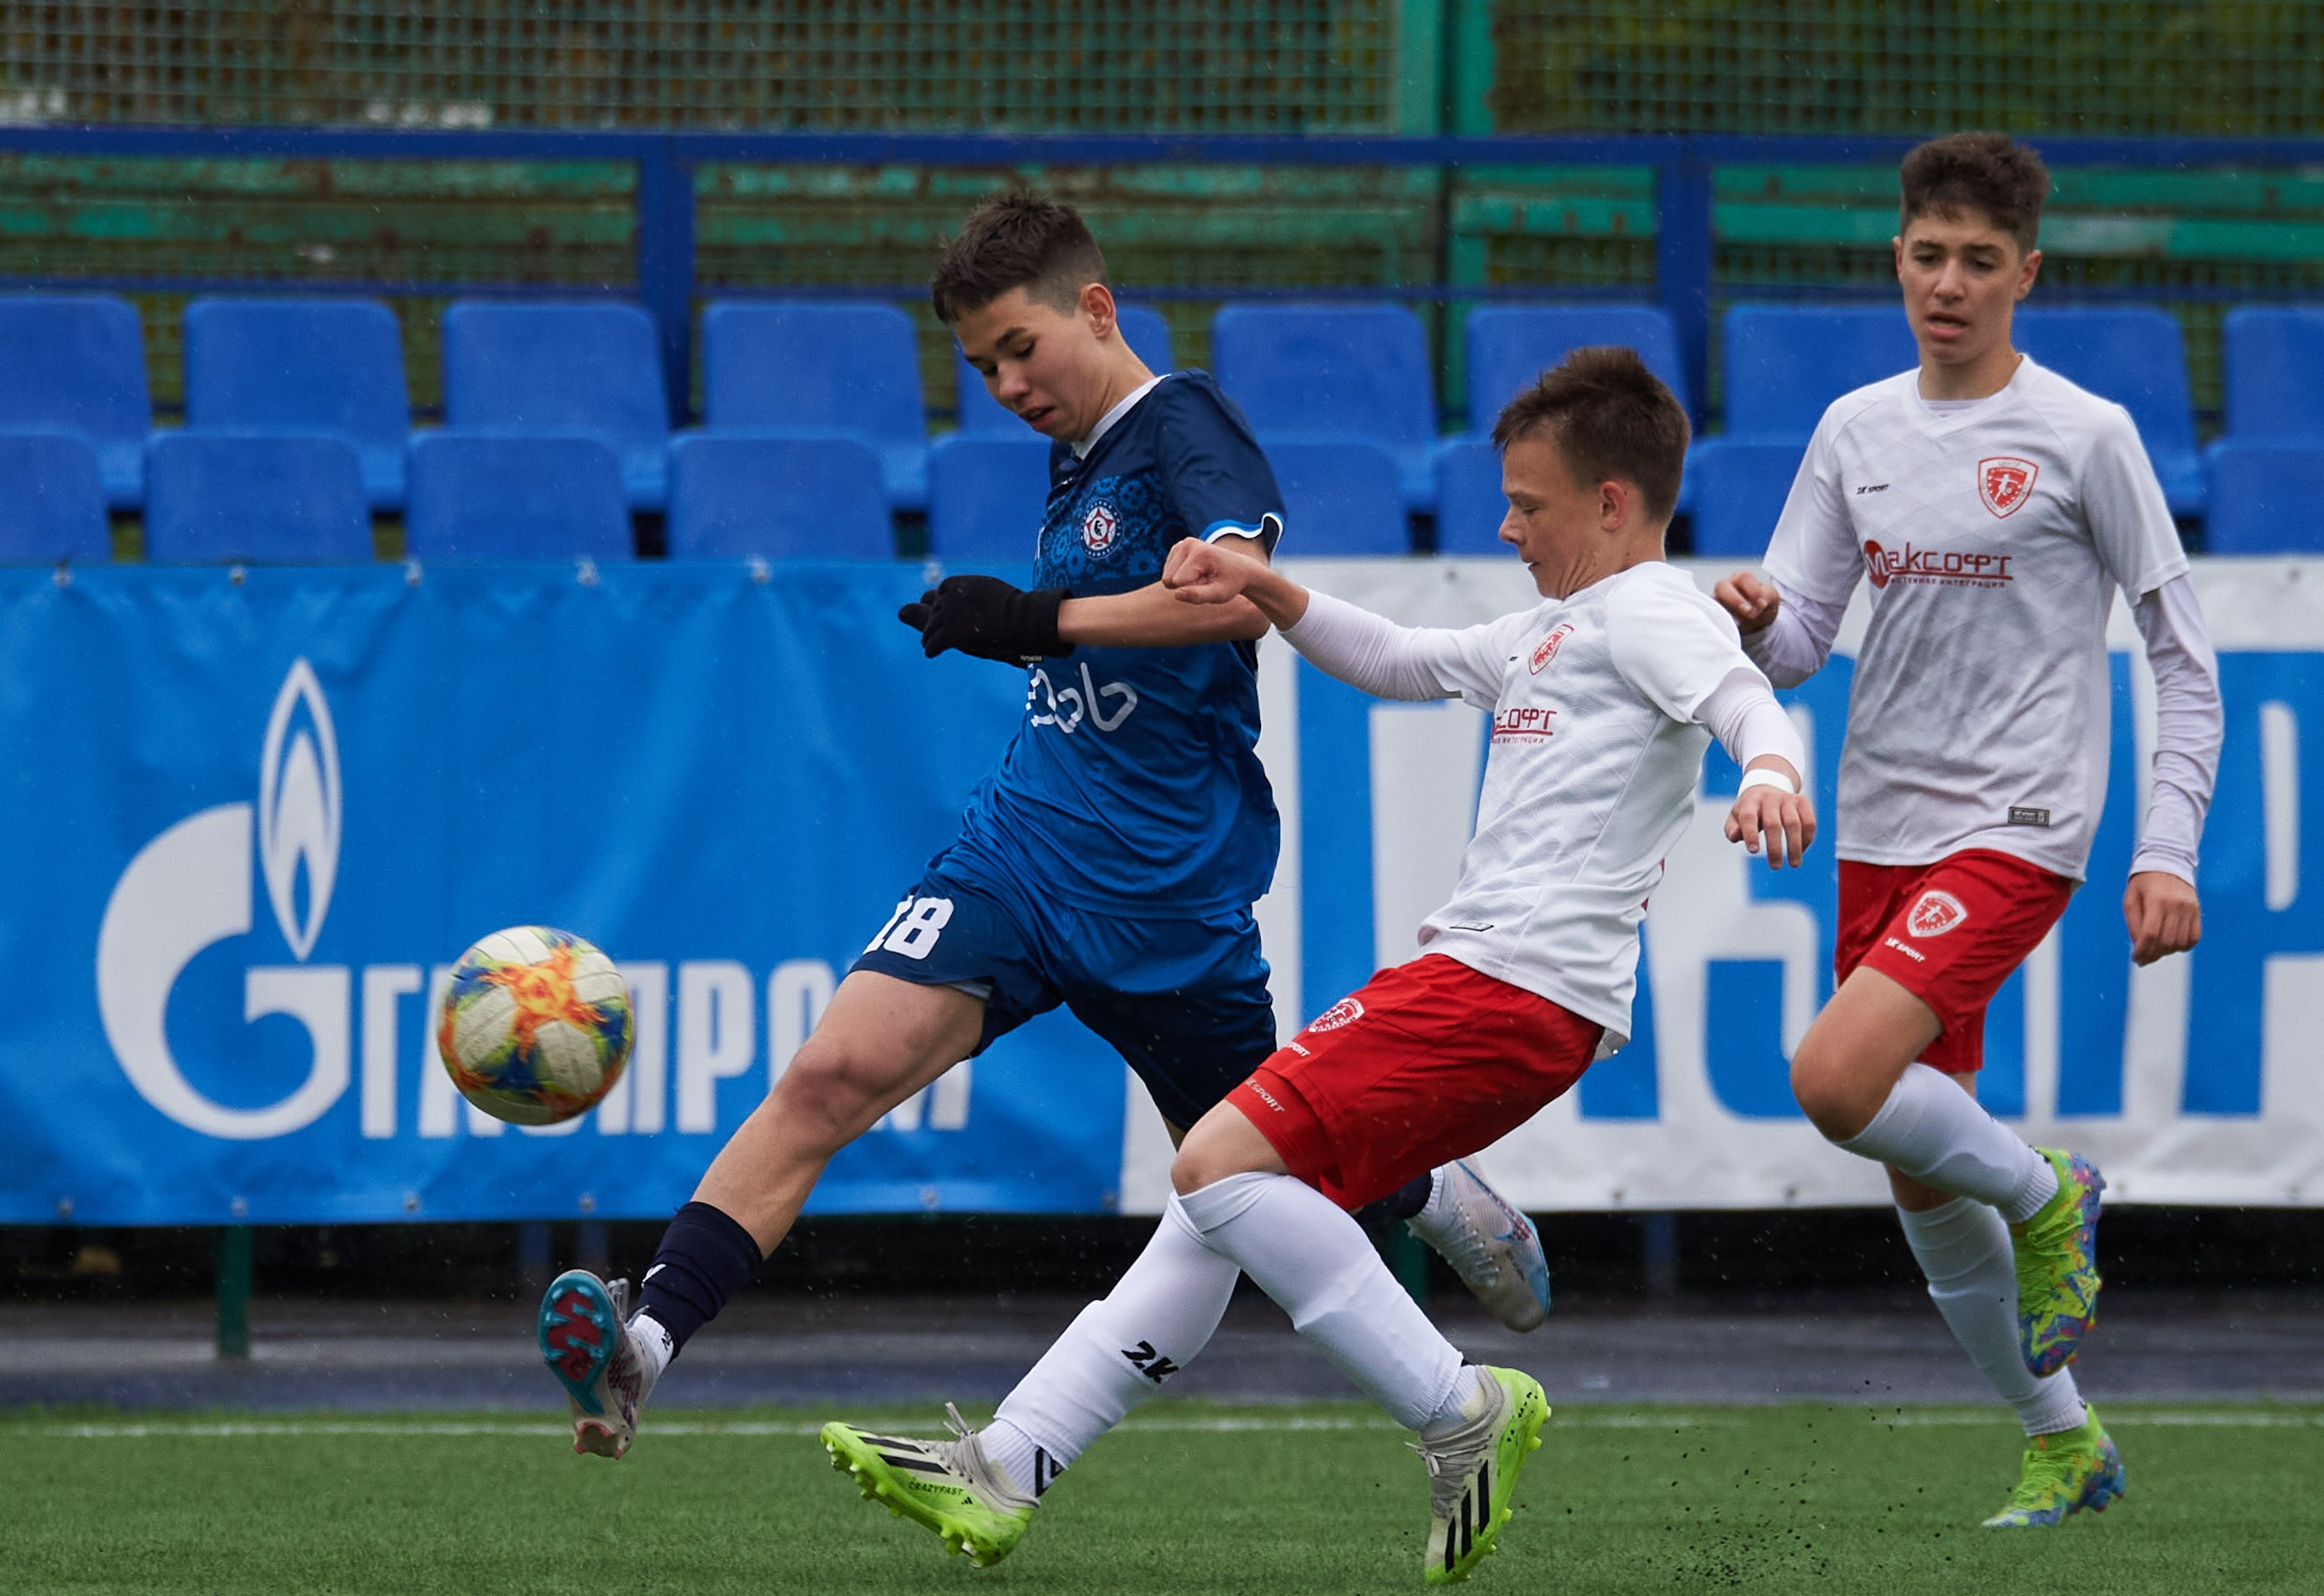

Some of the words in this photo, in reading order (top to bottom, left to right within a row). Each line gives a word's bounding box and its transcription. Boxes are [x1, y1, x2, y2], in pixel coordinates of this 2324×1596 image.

[862, 895, 955, 961] 18
[1252, 1083, 1285, 1113] SPORT
[1121, 1340, 1179, 1384] 2K
[908, 1480, 964, 1496] CRAZYFAST
